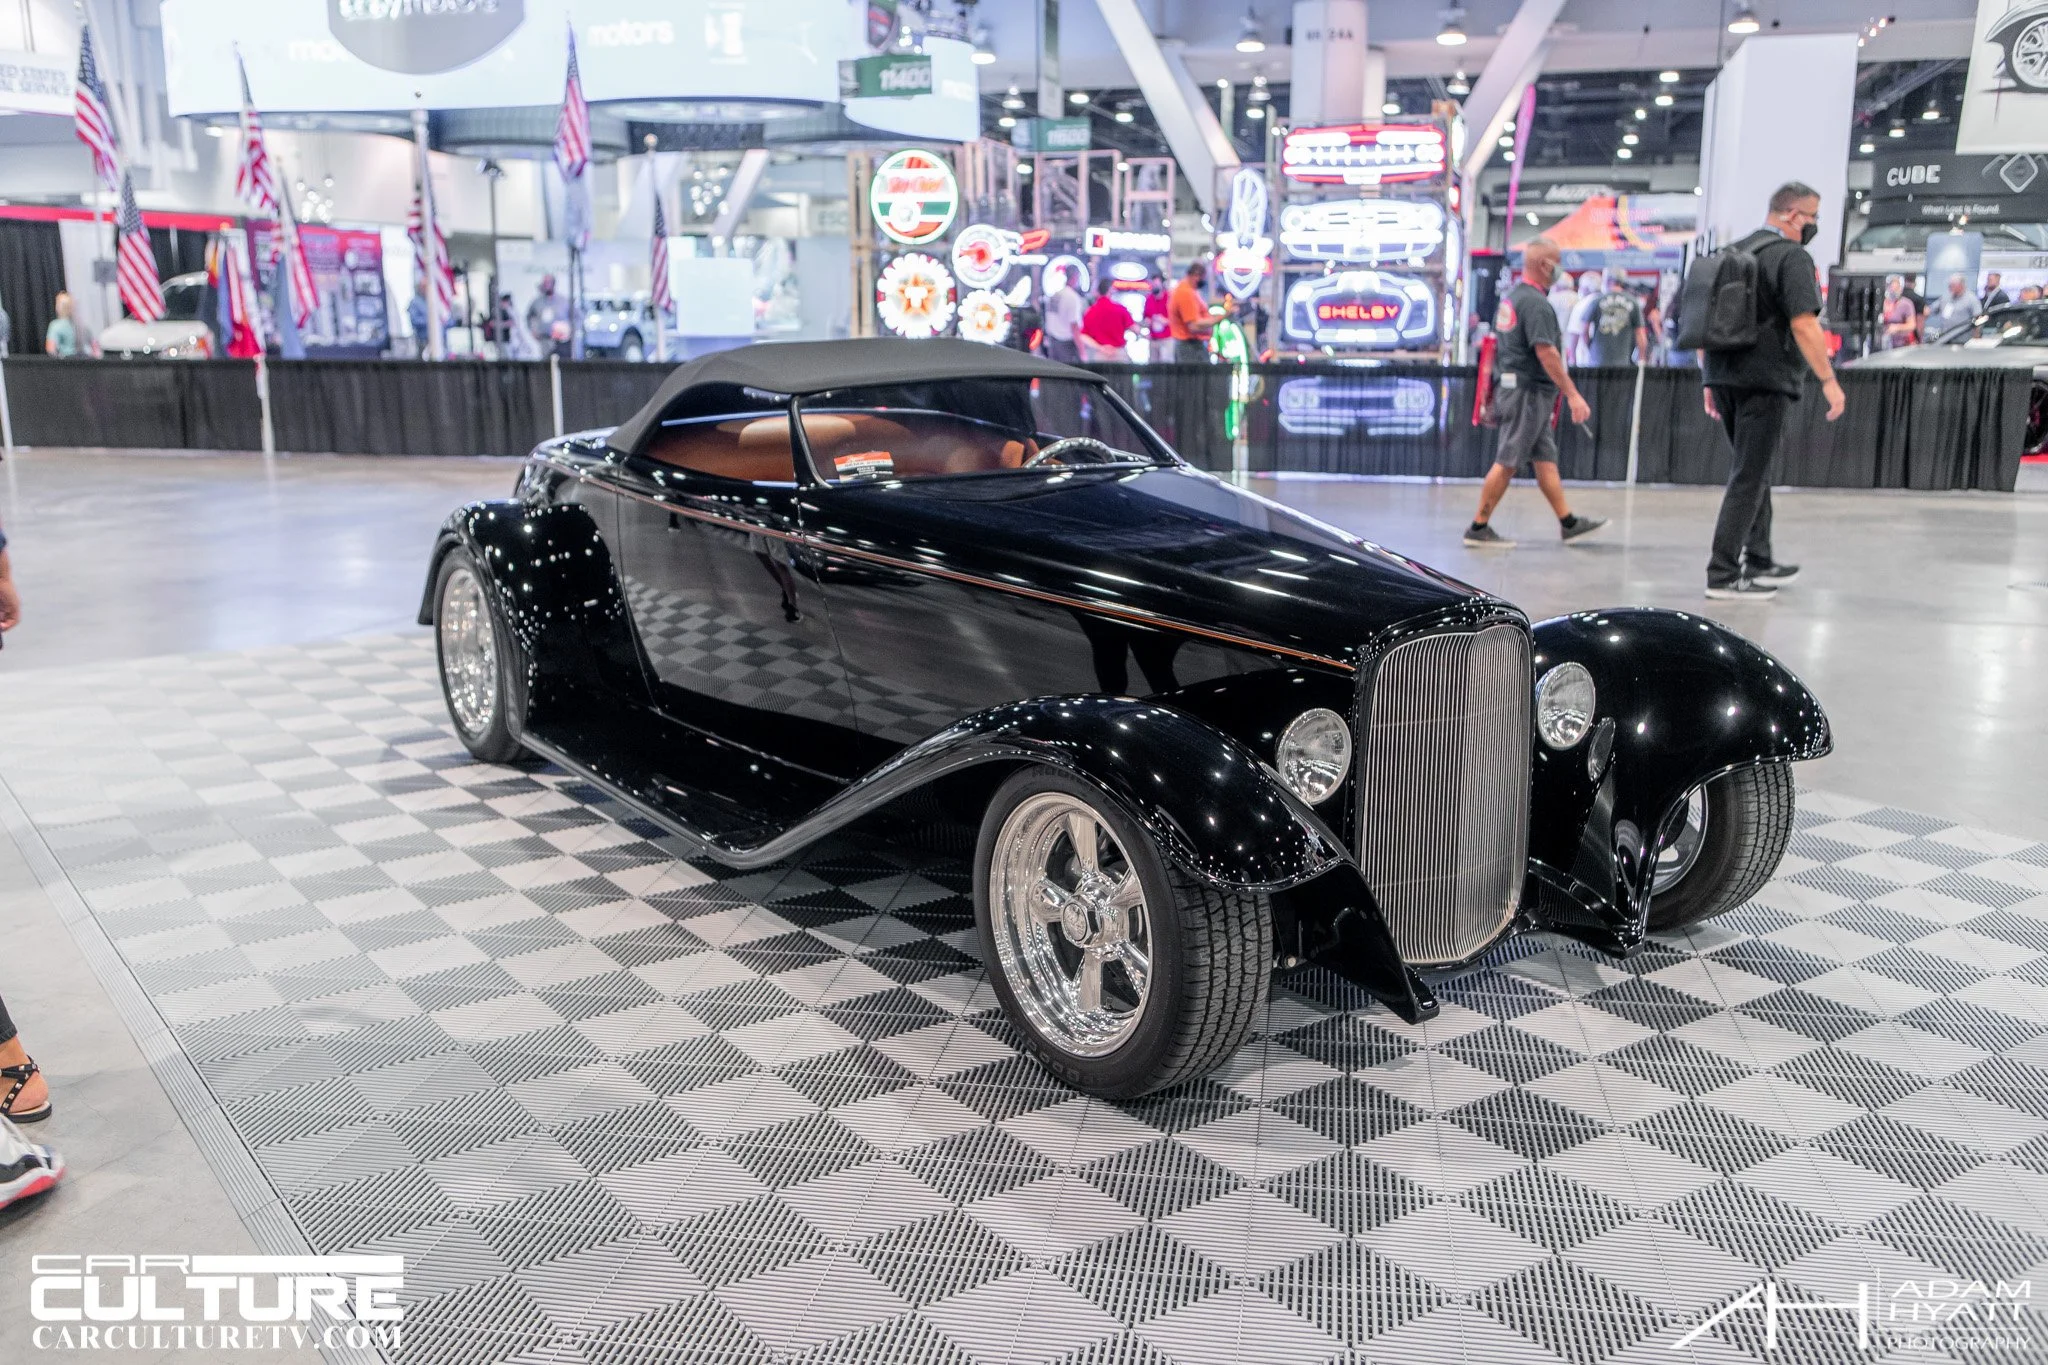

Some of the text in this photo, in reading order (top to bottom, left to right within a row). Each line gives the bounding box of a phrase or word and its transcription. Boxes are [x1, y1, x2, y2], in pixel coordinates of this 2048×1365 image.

[587, 17, 675, 48] motors
[879, 67, 931, 91] 11400
[1887, 164, 1941, 187] CUBE
[1318, 304, 1399, 321] SHELBY
